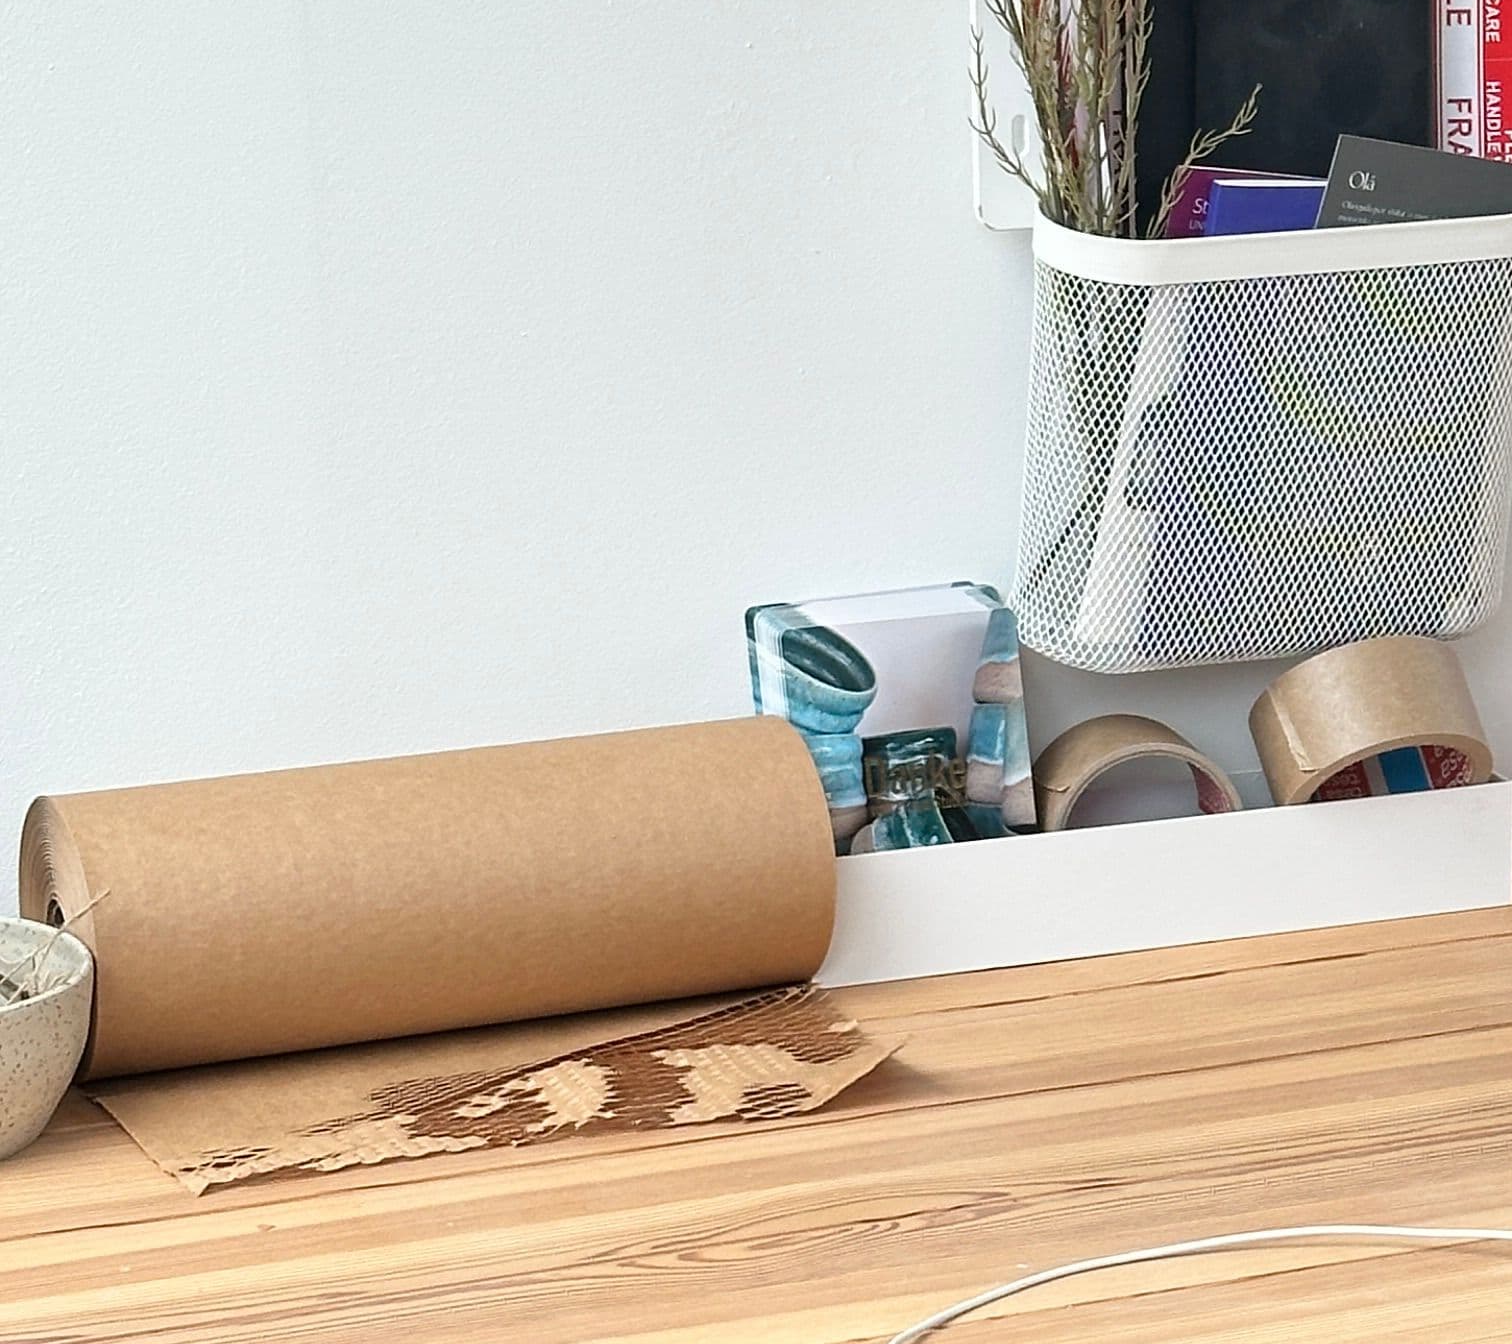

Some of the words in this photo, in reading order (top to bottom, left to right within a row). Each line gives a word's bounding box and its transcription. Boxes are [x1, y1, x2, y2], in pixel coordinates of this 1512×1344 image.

[1447, 98, 1473, 158] FRA
[1485, 80, 1502, 154] HANDLE
[1191, 197, 1210, 216] St
